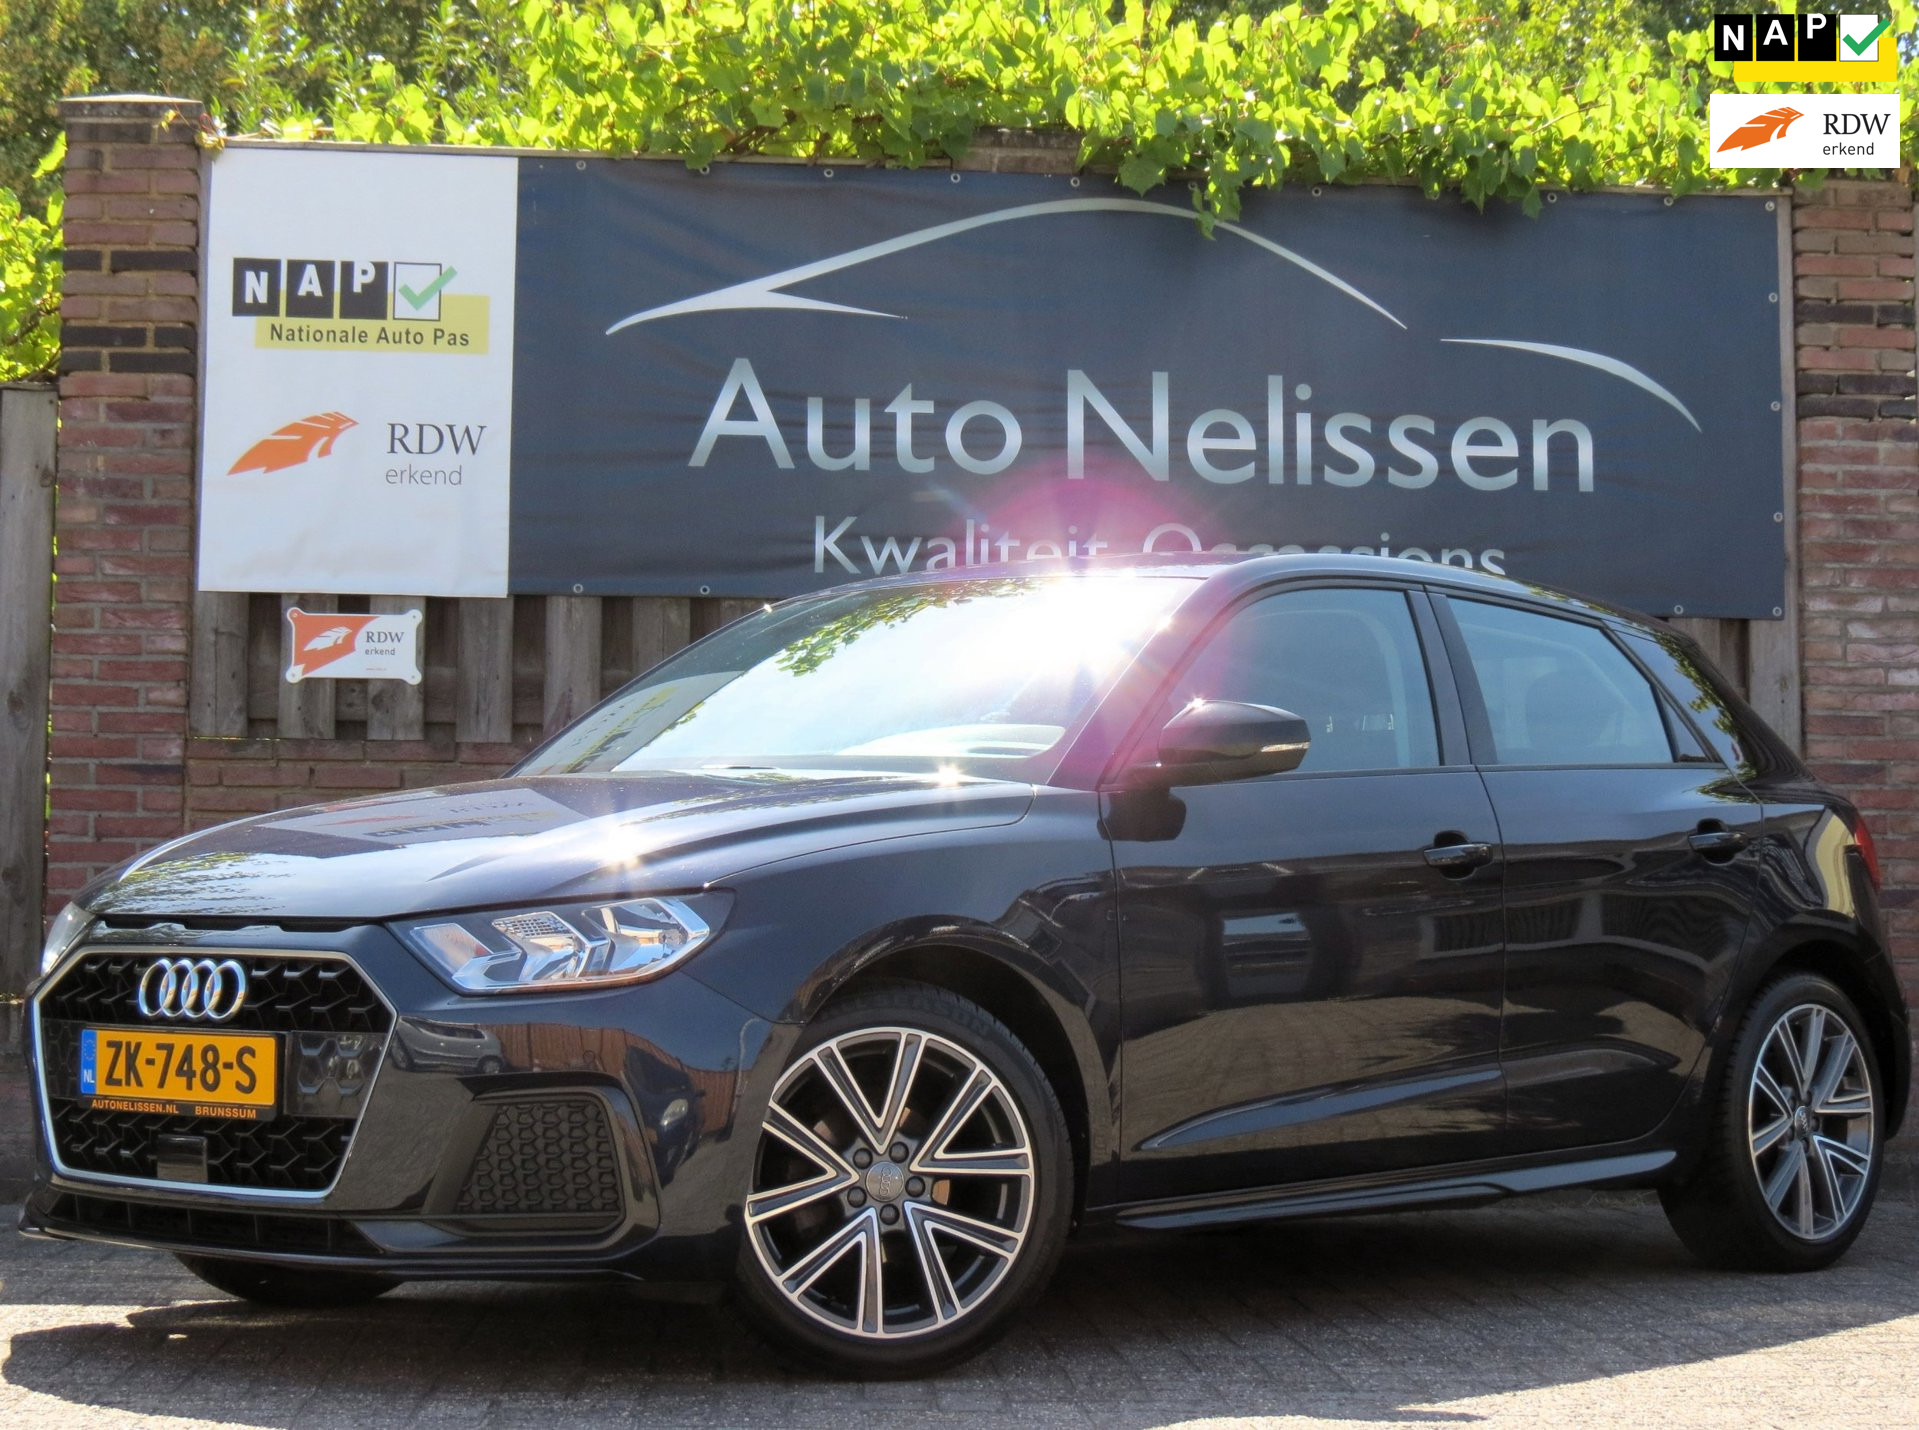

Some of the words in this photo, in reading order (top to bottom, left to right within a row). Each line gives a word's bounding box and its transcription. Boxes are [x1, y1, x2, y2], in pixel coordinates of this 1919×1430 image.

[244, 261, 375, 304] NAP
[270, 323, 368, 344] Nationale
[376, 326, 424, 345] Auto
[433, 328, 470, 347] Pas
[687, 357, 1023, 475] Auto
[1067, 369, 1594, 492] Nelissen
[387, 422, 488, 455] RDW
[385, 464, 462, 486] erkend
[365, 631, 405, 643] RDW
[365, 647, 396, 656] erkend
[83, 1069, 95, 1084] NL
[105, 1040, 257, 1094] ZK-748-S
[91, 1099, 179, 1114] AUTONELISSEN.NL
[195, 1106, 257, 1119] BRUNSSUM
